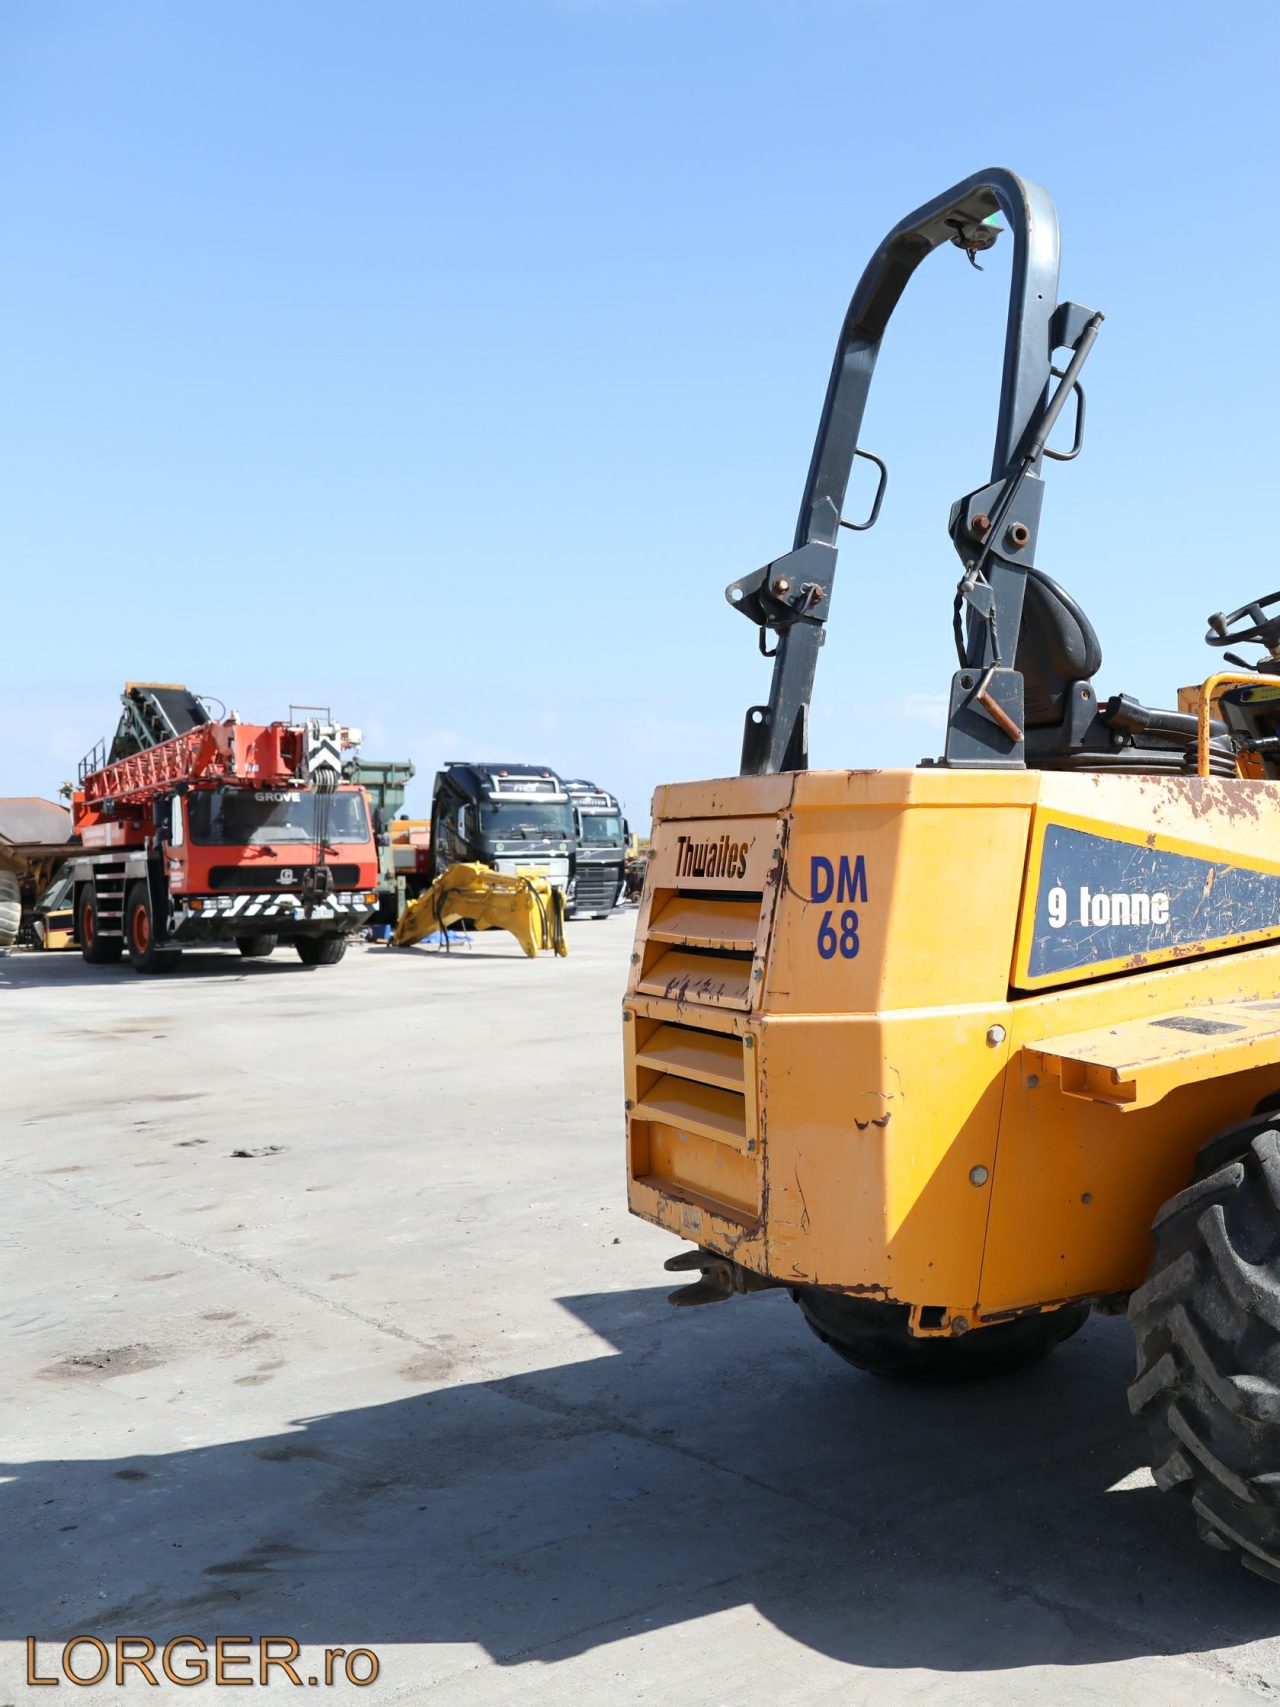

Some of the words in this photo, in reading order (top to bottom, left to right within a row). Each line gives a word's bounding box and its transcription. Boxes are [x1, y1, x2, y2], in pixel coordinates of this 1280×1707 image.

[254, 791, 301, 803] GROVE
[675, 834, 749, 879] Thwaites
[810, 855, 868, 904] DM
[1047, 886, 1067, 928] 9
[1080, 886, 1169, 926] tonne
[817, 909, 860, 960] 68
